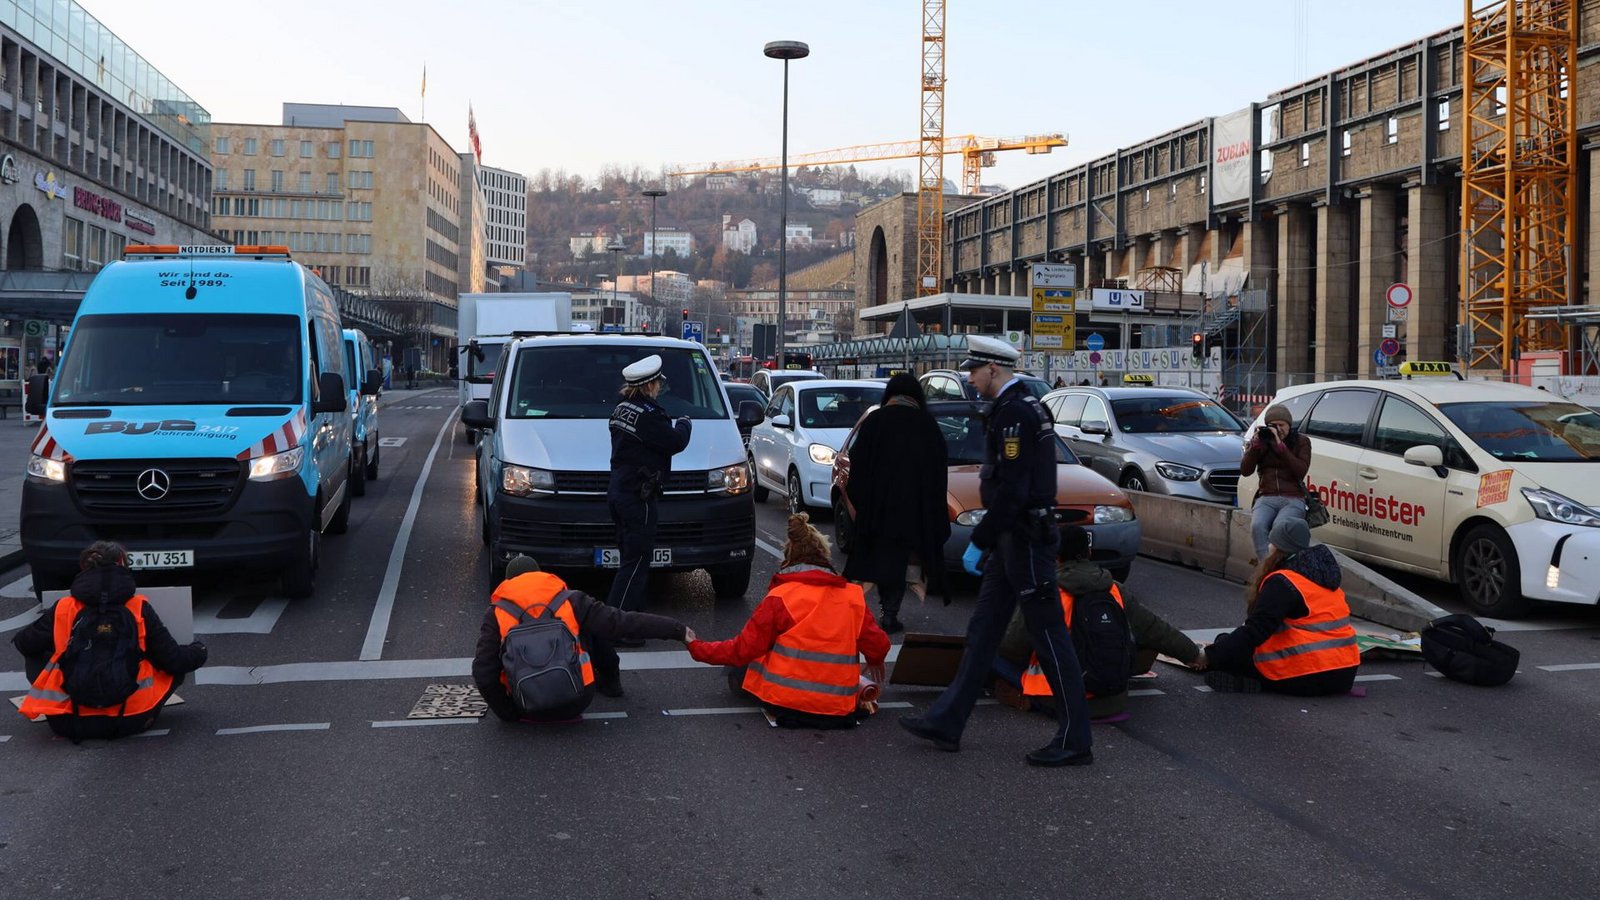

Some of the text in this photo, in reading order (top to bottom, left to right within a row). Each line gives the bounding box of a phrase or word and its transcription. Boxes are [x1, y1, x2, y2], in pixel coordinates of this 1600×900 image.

[181, 246, 232, 254] NOTDIENST
[1110, 292, 1120, 302] U
[684, 323, 691, 334] P
[1415, 363, 1446, 372] TAXI
[151, 430, 237, 440] Rohrreinigung
[1332, 514, 1414, 543] Erlebnis-Wohnzentrum
[143, 553, 160, 566] TV
[163, 552, 188, 565] 351
